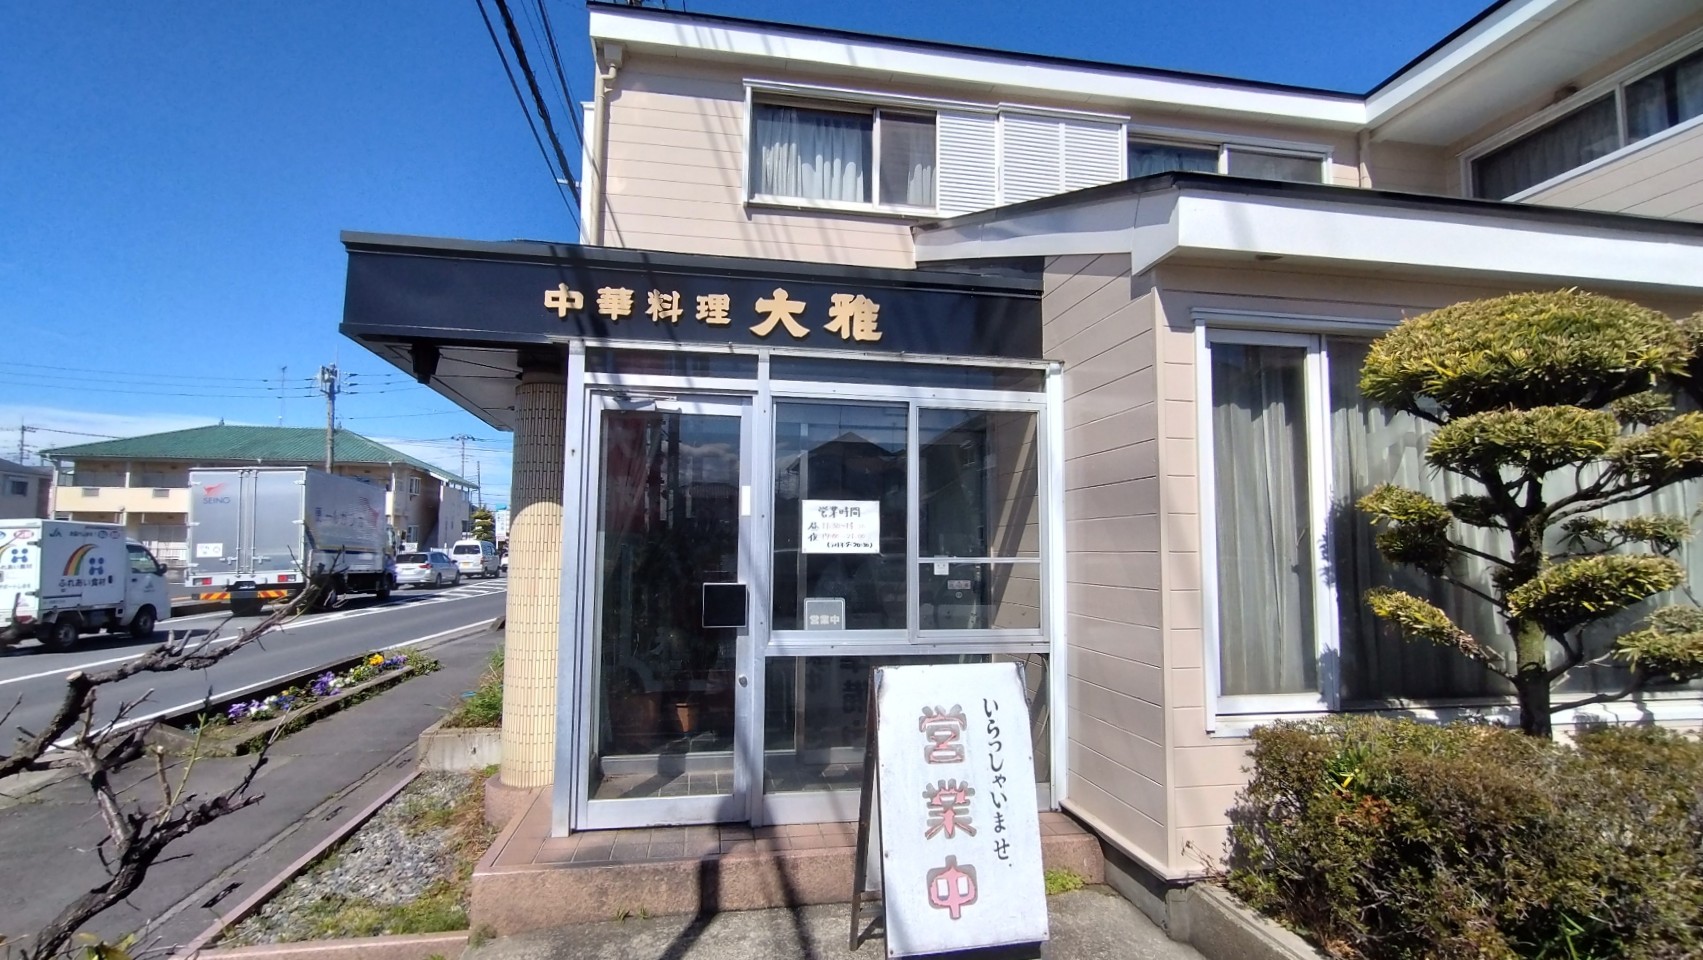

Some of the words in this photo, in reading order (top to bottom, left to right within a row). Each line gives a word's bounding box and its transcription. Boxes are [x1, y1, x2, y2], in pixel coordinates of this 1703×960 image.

[543, 282, 732, 325] 中華料理
[748, 287, 884, 342] 大雅
[202, 496, 231, 504] SEINO
[818, 506, 861, 518] 営業時間
[809, 614, 840, 625] 営業中
[918, 703, 979, 920] 営業中
